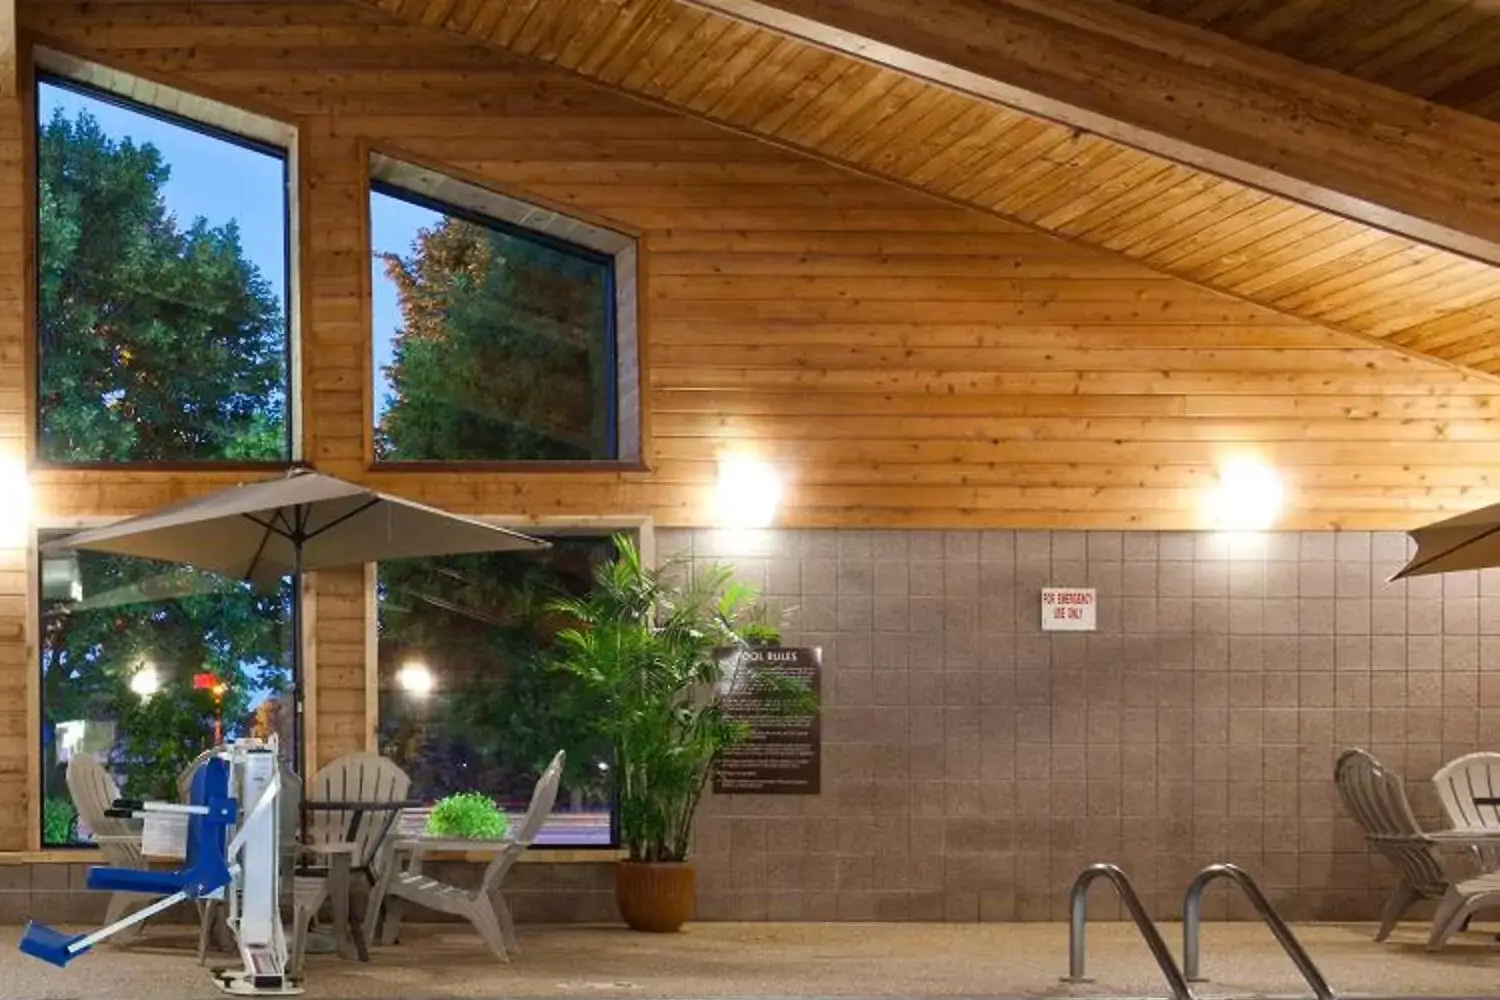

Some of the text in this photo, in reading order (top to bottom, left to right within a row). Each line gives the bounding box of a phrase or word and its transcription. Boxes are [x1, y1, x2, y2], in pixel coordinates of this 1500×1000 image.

[1043, 592, 1094, 605] FOR EMERGENCY
[1053, 607, 1083, 619] USE ONLY
[735, 651, 798, 661] OOL RULES
